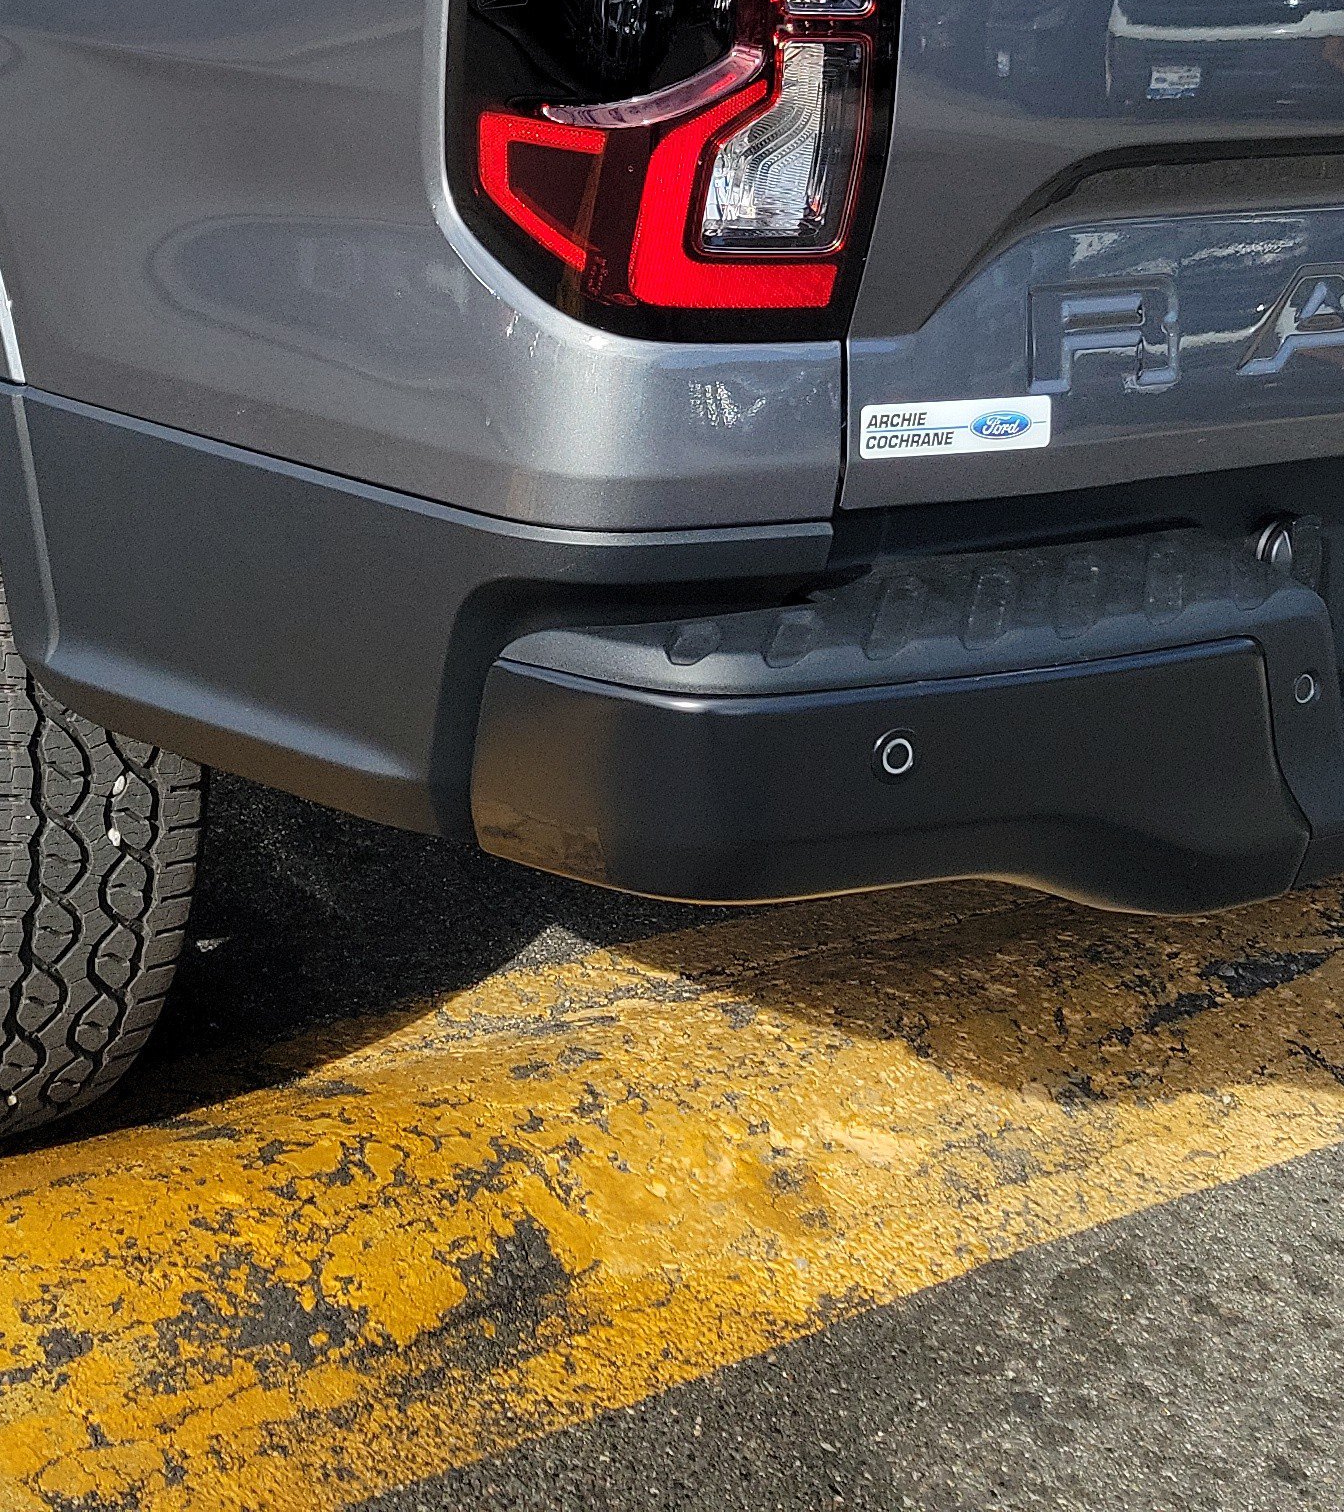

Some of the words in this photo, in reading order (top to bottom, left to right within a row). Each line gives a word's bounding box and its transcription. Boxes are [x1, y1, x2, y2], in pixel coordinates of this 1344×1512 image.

[865, 412, 928, 430] ARCHIE
[981, 415, 1020, 435] Ford
[865, 431, 955, 450] COCHRANE
